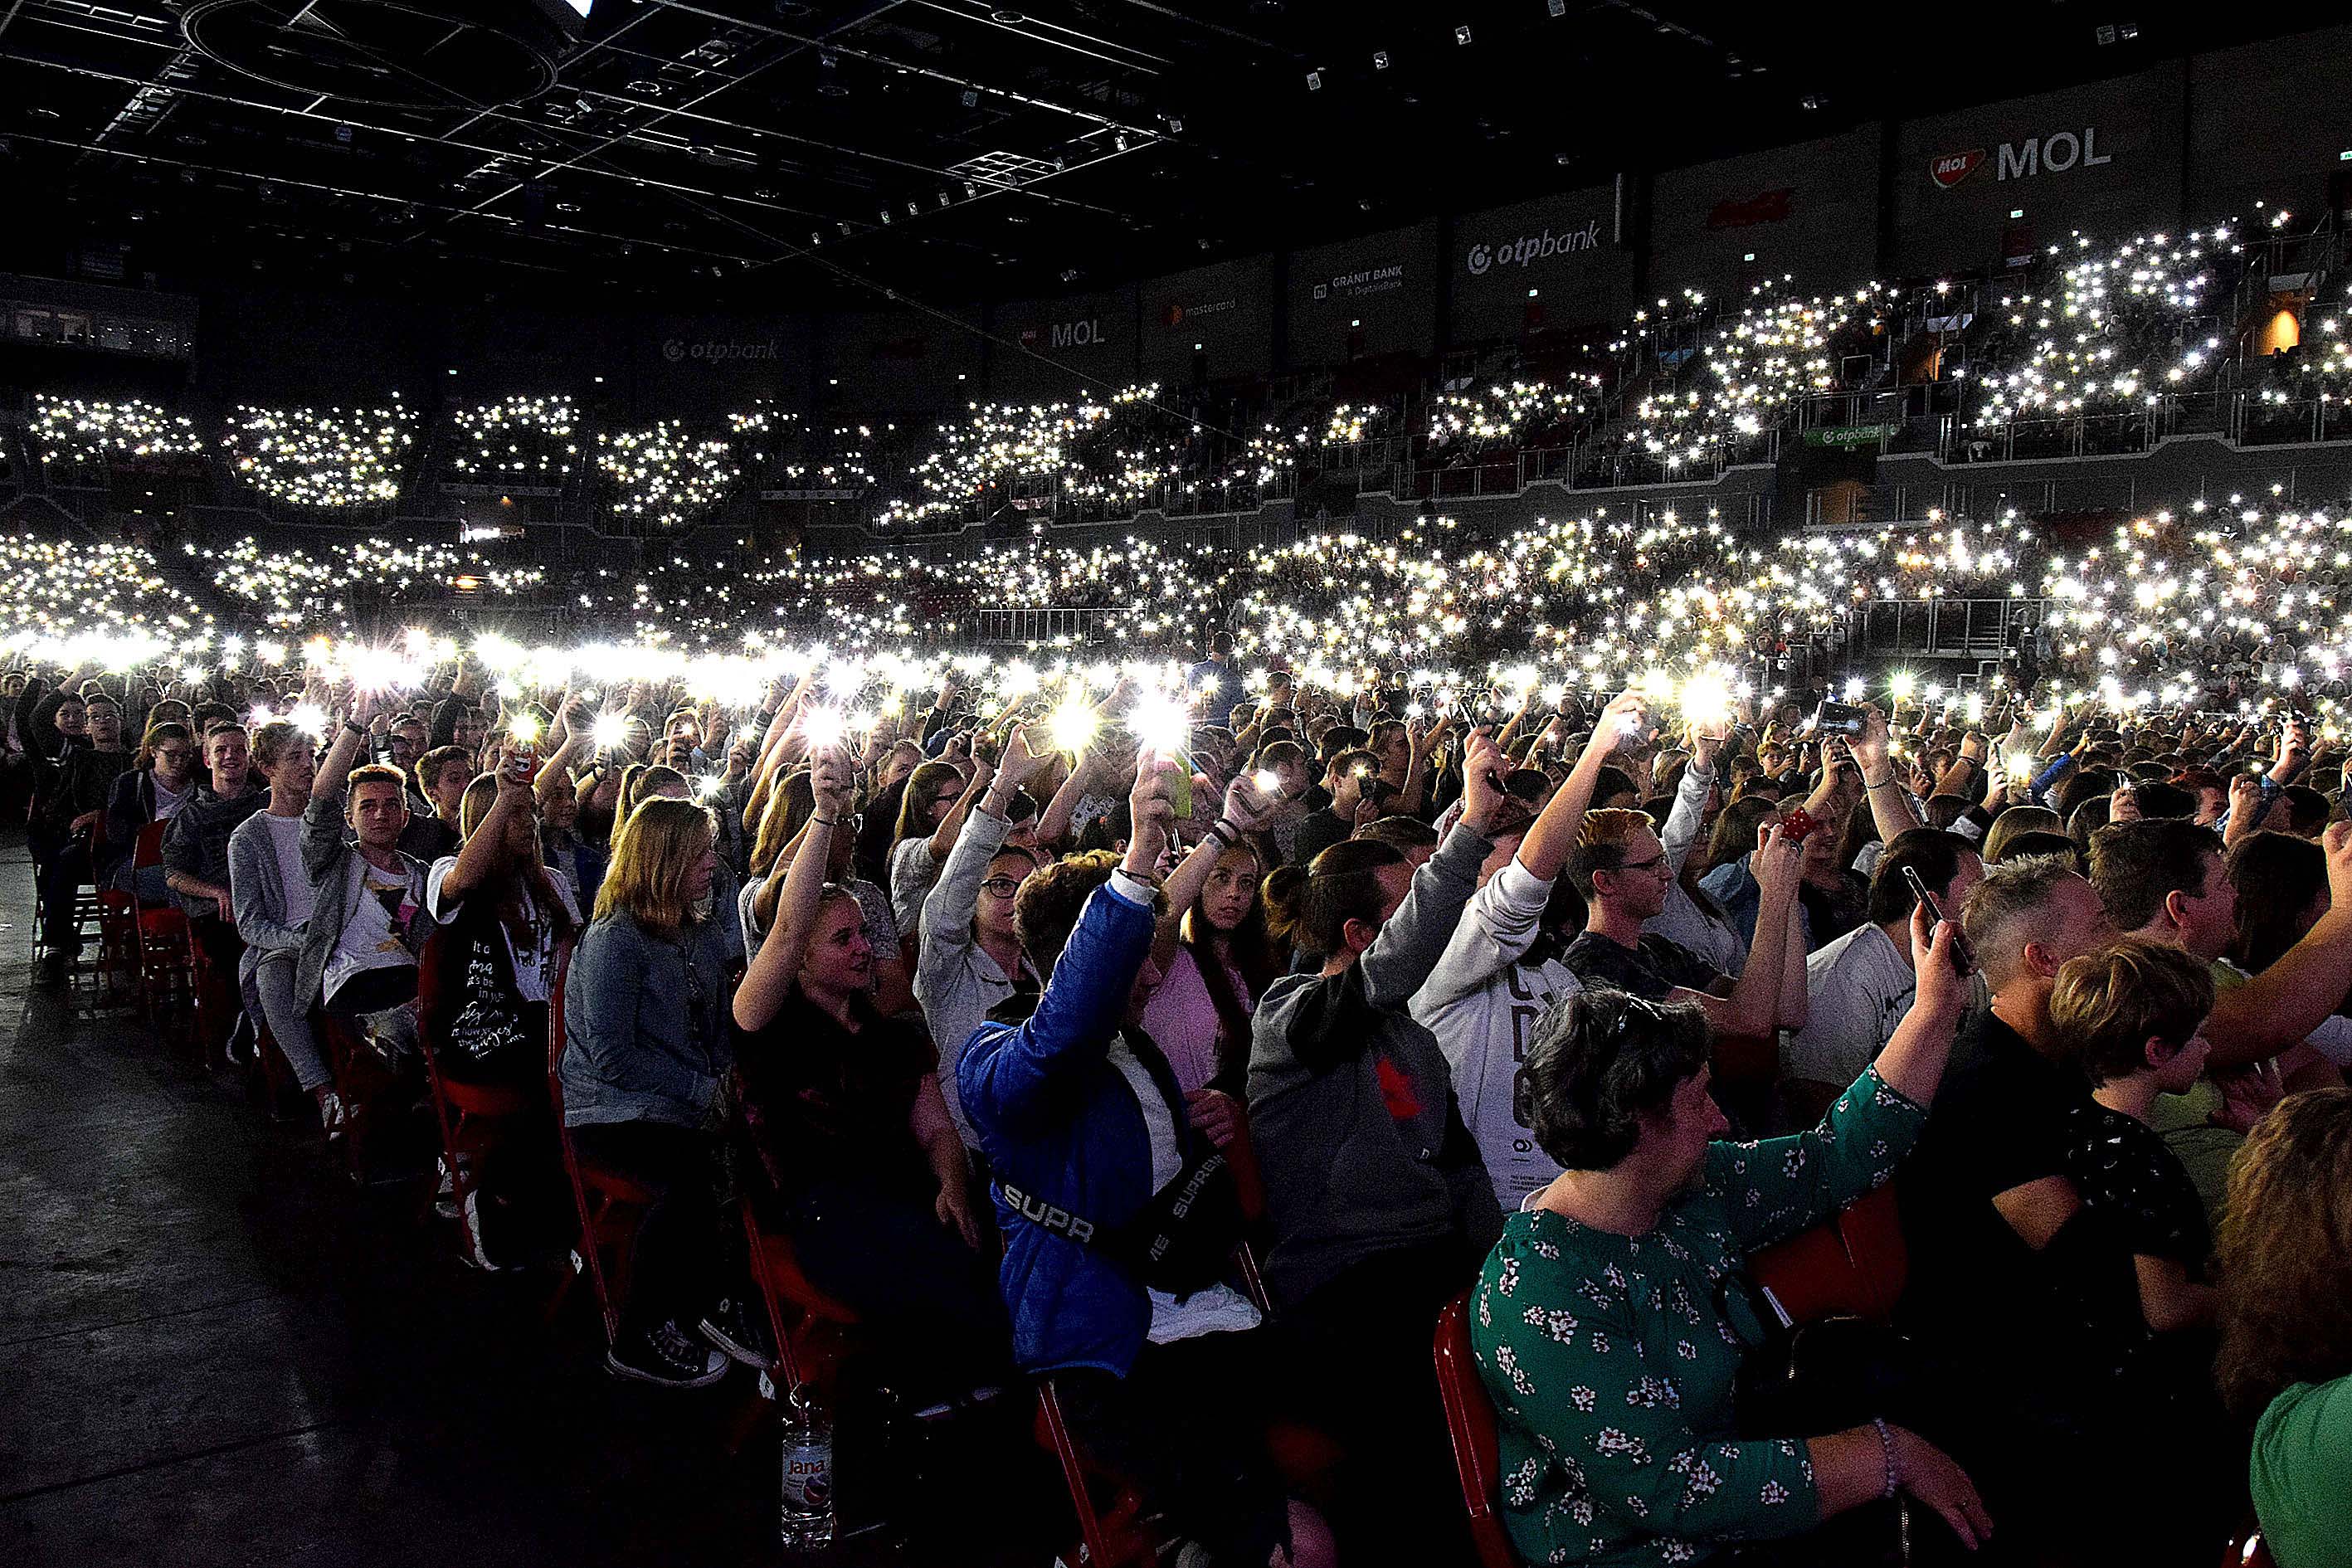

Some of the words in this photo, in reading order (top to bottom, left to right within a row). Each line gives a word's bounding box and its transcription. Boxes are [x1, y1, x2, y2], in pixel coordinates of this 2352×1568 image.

[1937, 156, 1967, 173] MOL
[1997, 127, 2111, 181] MOL
[1497, 220, 1601, 267] otpbank
[1332, 271, 1371, 288] GRÁNIT
[1372, 265, 1403, 280] BANK
[1185, 297, 1236, 318] mastercard
[1050, 318, 1106, 348] MOL
[689, 339, 778, 365] otpbank
[1836, 426, 1881, 443] otpbank
[1004, 1184, 1094, 1244] SUPR
